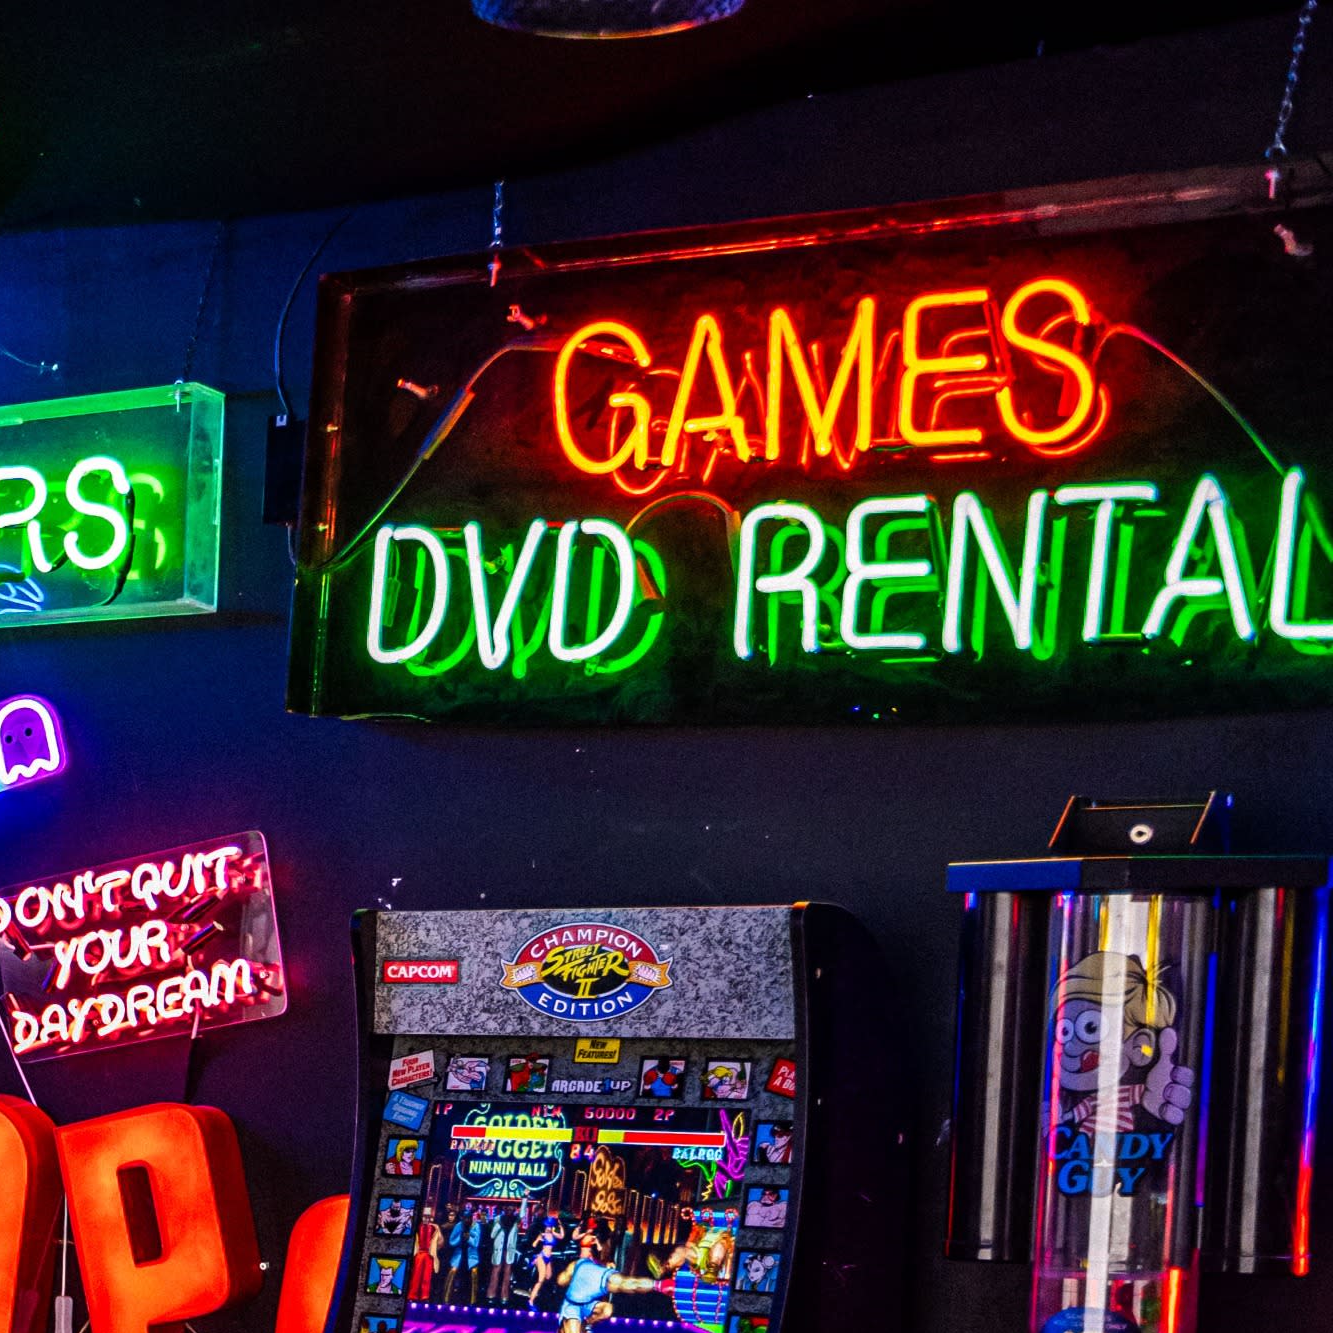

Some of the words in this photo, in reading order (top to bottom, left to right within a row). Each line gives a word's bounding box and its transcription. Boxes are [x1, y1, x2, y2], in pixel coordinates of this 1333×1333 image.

[552, 277, 1101, 476] GAMES
[367, 518, 633, 670] DVD
[131, 845, 243, 910] QUIT
[53, 919, 171, 990] YOUR
[529, 928, 643, 959] CHAMPION
[561, 951, 630, 978] FIGHTER
[387, 965, 455, 980] CAPCOM
[575, 978, 599, 999] II
[11, 957, 253, 1056] DAYDREAM
[537, 991, 634, 1018] EDITION
